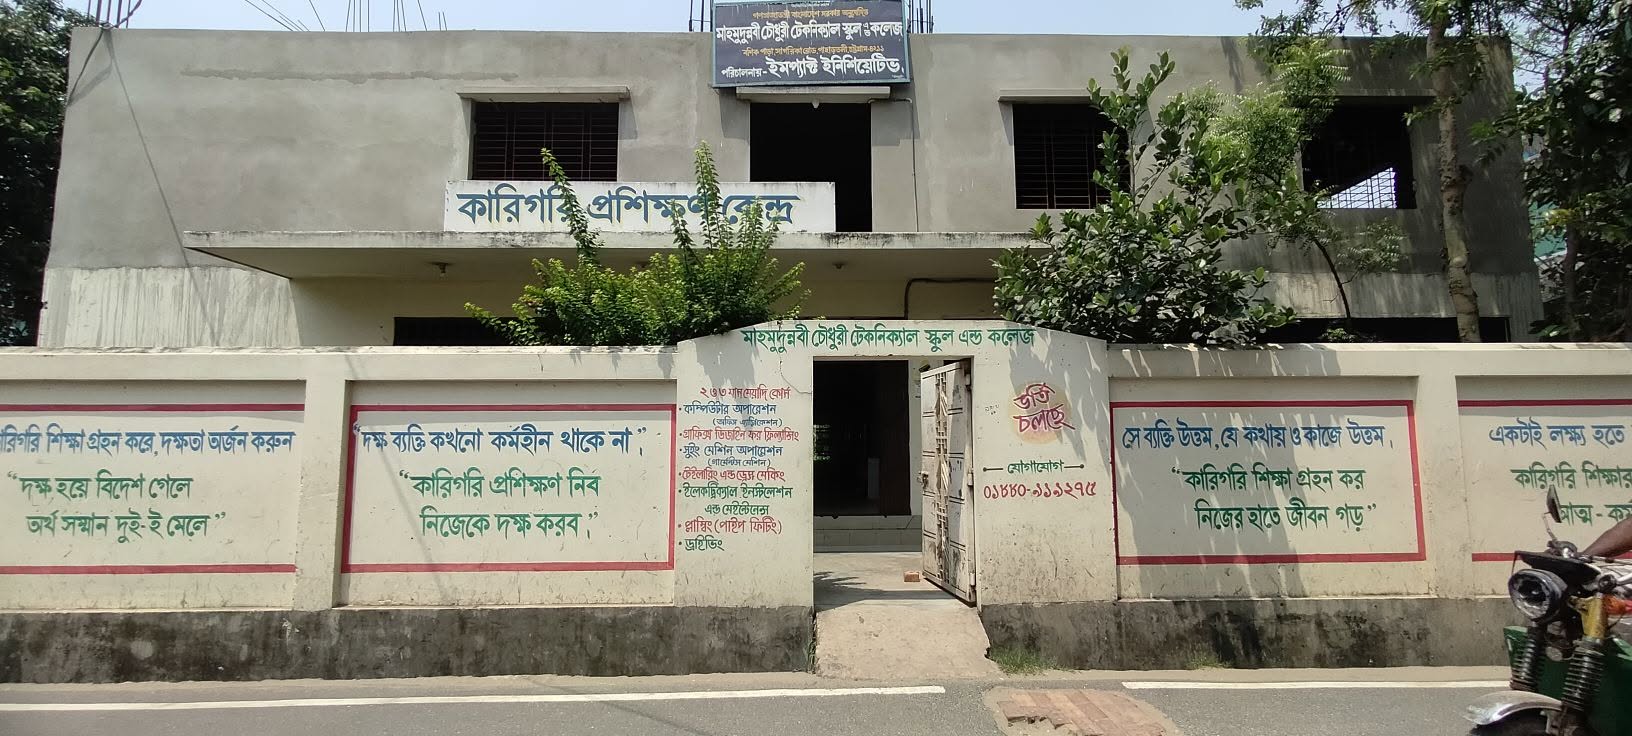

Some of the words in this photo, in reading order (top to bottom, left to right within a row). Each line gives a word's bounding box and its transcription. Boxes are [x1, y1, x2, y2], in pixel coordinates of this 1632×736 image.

[716, 21, 761, 45] মাহমুদুন্নবী
[761, 20, 789, 42] চৌধুরী
[790, 20, 841, 39] টেকনিক্যাল
[842, 22, 862, 41] স্কুল
[869, 21, 903, 38] কলেজ
[766, 56, 818, 78] ইমপ্যাক্ট
[456, 183, 572, 224] কারিগরি
[587, 185, 710, 224] প্রশিক্ষণ
[741, 324, 810, 353] মাহমুদুন্নবী
[812, 323, 848, 350] চৌধুরী
[851, 323, 919, 348] টেকনিক্যাল
[925, 328, 954, 352] স্কুল
[958, 328, 982, 346] এন্ড
[987, 327, 1036, 348] কলেজ
[700, 387, 709, 398] ২
[1013, 382, 1056, 410] ভর্তি
[683, 400, 729, 415] কম্পিউটার
[732, 403, 777, 416] অপারেশন
[1012, 403, 1076, 433] চলছে
[0, 423, 42, 454] ারিগরি
[46, 422, 86, 454] শিক্ষা
[87, 428, 122, 457] গ্রহন
[159, 428, 206, 456] দক্ষতা
[208, 425, 249, 454] অর্জন
[251, 431, 296, 454] করুন
[390, 423, 426, 453] ব্যক্তি
[428, 427, 484, 454] কখনো
[488, 423, 554, 457] কর্মহীন
[560, 426, 606, 454] থাকে
[715, 426, 746, 441] ডিজাইন
[748, 429, 762, 441] ফর
[1122, 427, 1141, 449] সে
[1143, 418, 1175, 449] ব্যক্তি
[1221, 426, 1239, 448] যে
[1242, 422, 1287, 449] কথায়
[1290, 426, 1302, 446] ও
[1301, 423, 1342, 449] কাজে
[1489, 416, 1548, 450] একটাই
[1546, 425, 1587, 446] লক্ষ্য
[1591, 424, 1625, 449] হতে
[683, 442, 701, 459] সুইং
[703, 442, 734, 457] মেশিন
[736, 445, 783, 457] অপারেশন
[682, 466, 718, 481] টেইলারিং
[720, 469, 736, 481] এন্ড
[736, 469, 755, 482] ড্রেস
[757, 467, 786, 482] মেকিং
[1007, 459, 1065, 475] যোগাযোগ
[1251, 461, 1293, 491] শিক্ষা
[1296, 466, 1334, 493] গ্রহন
[1337, 469, 1366, 490] কর
[1510, 460, 1578, 490] কারিগরি
[55, 477, 93, 501] হয়ে
[95, 468, 146, 500] বিদেশ
[149, 473, 194, 500] গেলে
[489, 466, 563, 498] প্রশিক্ষণ
[566, 466, 602, 498] নিব
[26, 509, 60, 537] অর্থ
[61, 511, 111, 537] সম্মান
[419, 504, 491, 540] নিজেকে
[493, 513, 532, 540] দক্ষ
[705, 504, 721, 515] এন্ড
[1194, 497, 1245, 531] নিজের
[1246, 503, 1281, 533] হাতে
[1284, 496, 1330, 531] জীবন
[714, 517, 746, 534] (পাইপ
[750, 516, 782, 534] ফিটিং)
[684, 535, 725, 551] ড্রাইভিং
